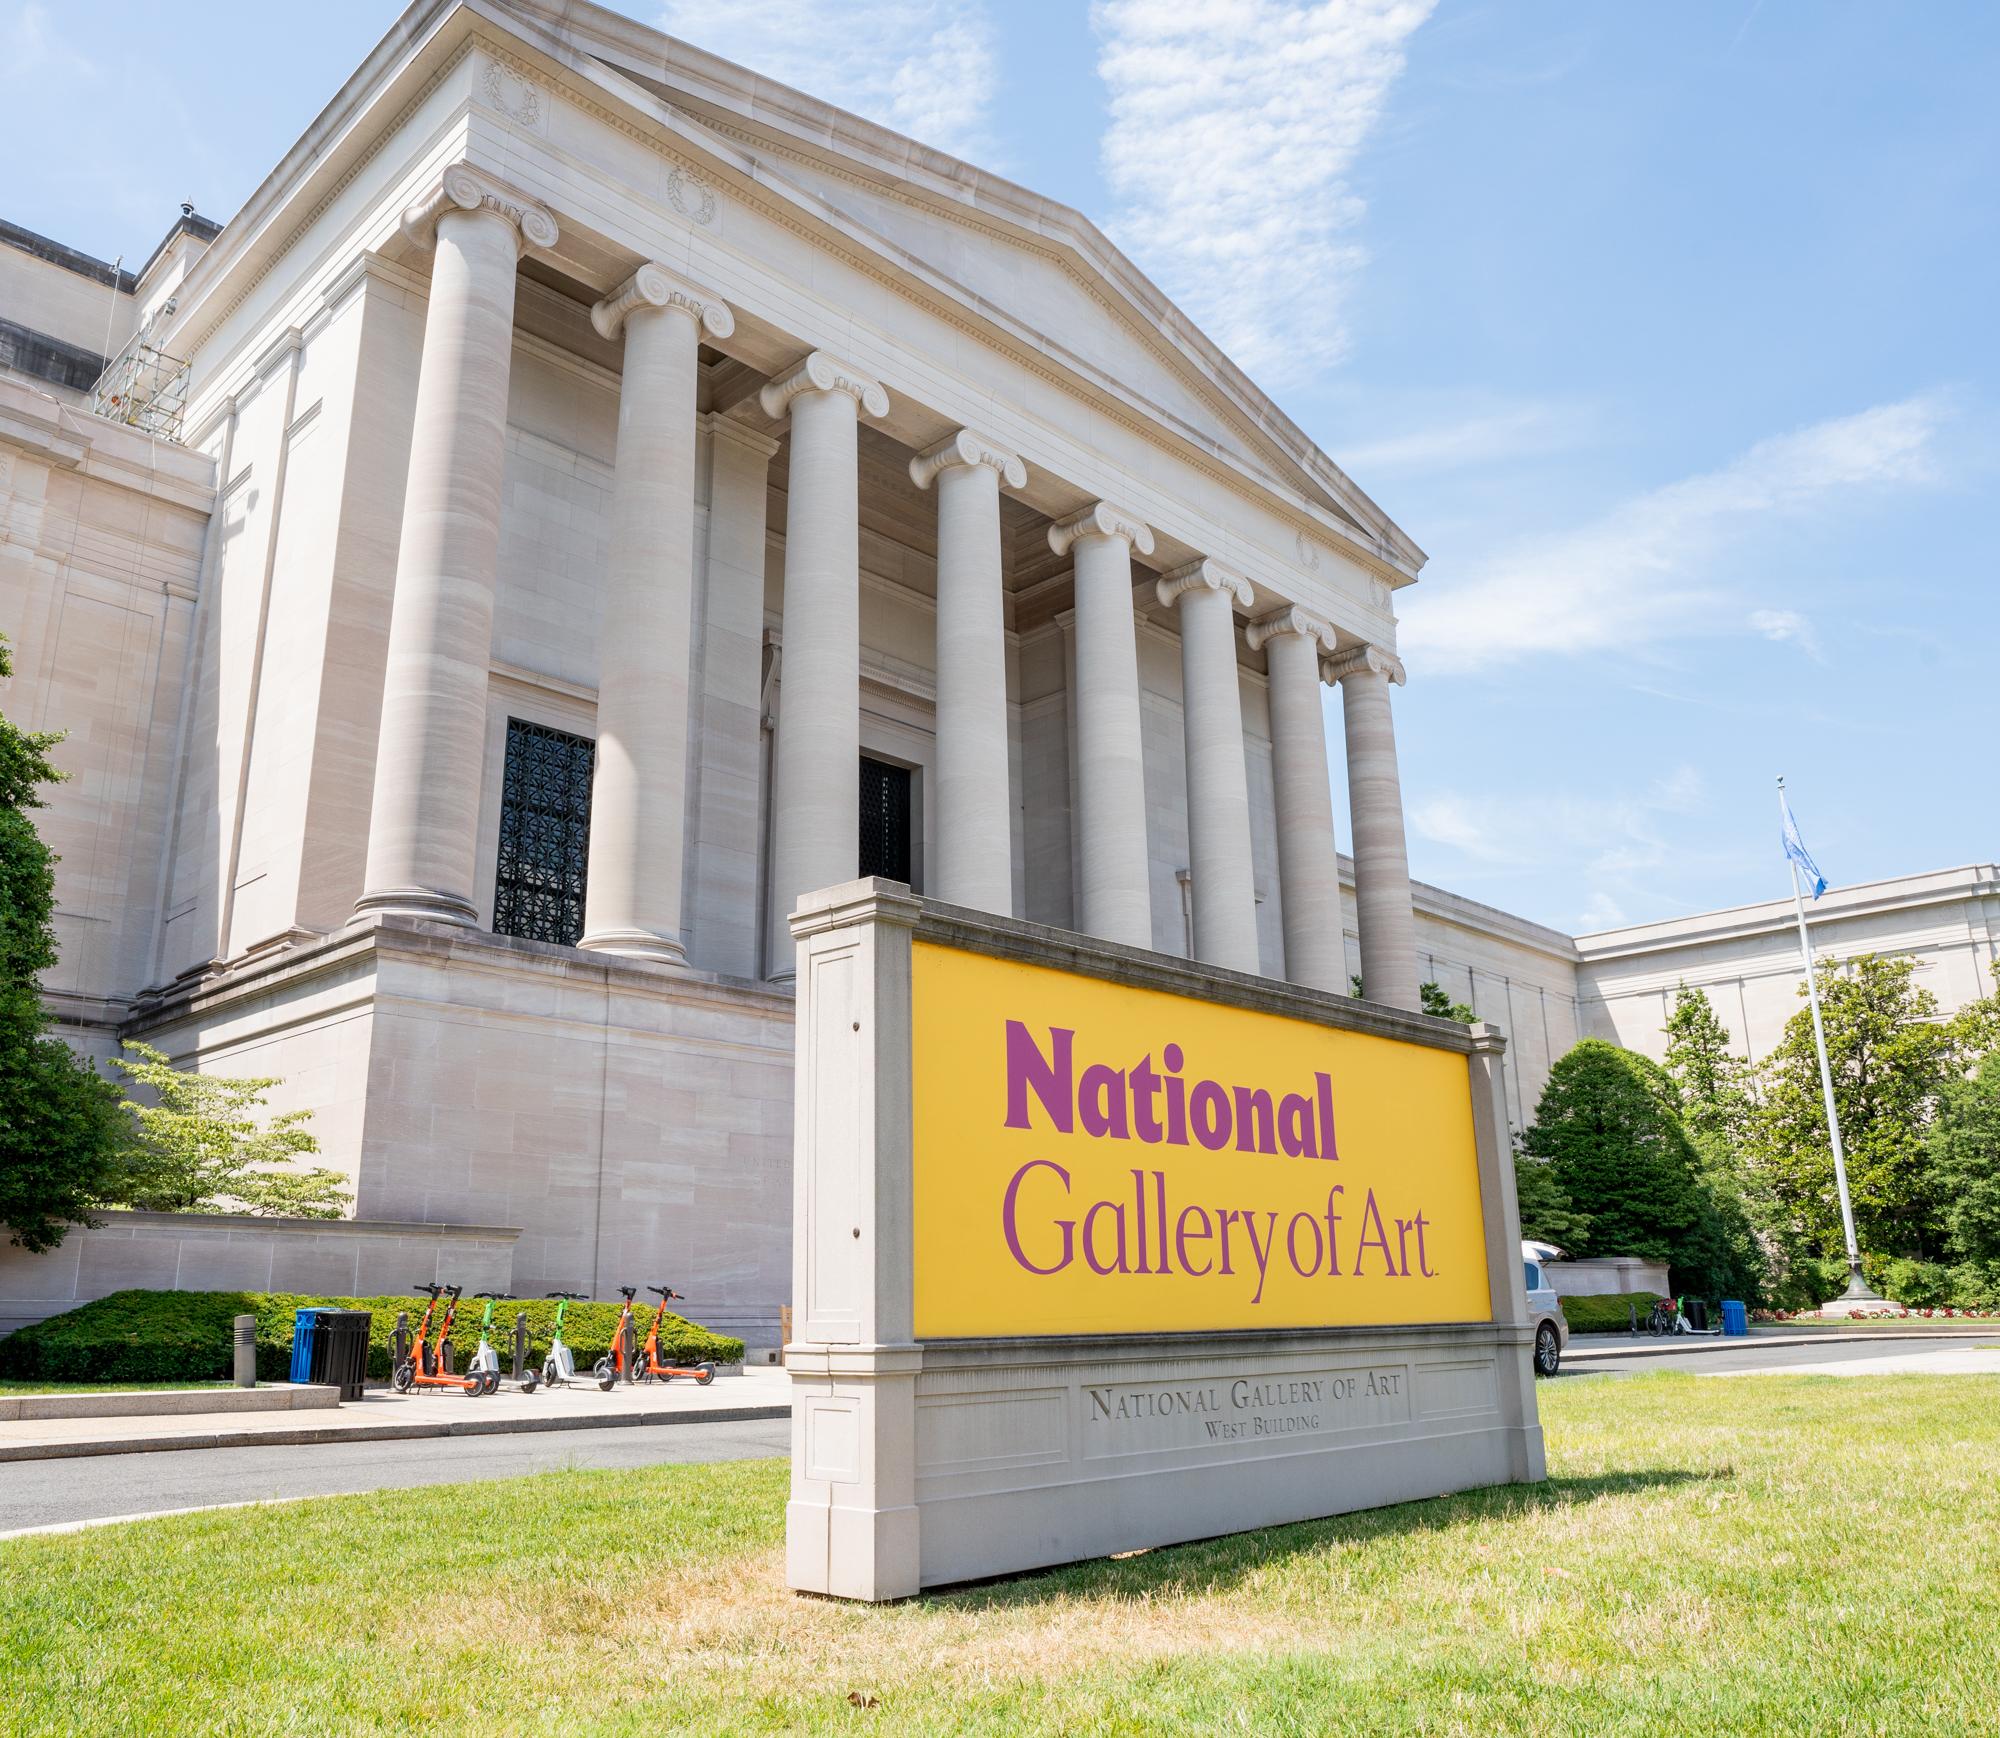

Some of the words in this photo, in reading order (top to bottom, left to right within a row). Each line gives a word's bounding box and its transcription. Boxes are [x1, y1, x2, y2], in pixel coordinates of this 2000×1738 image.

[1004, 1019, 1339, 1161] National
[1002, 1159, 1278, 1304] Gallery
[1287, 1184, 1345, 1278] of
